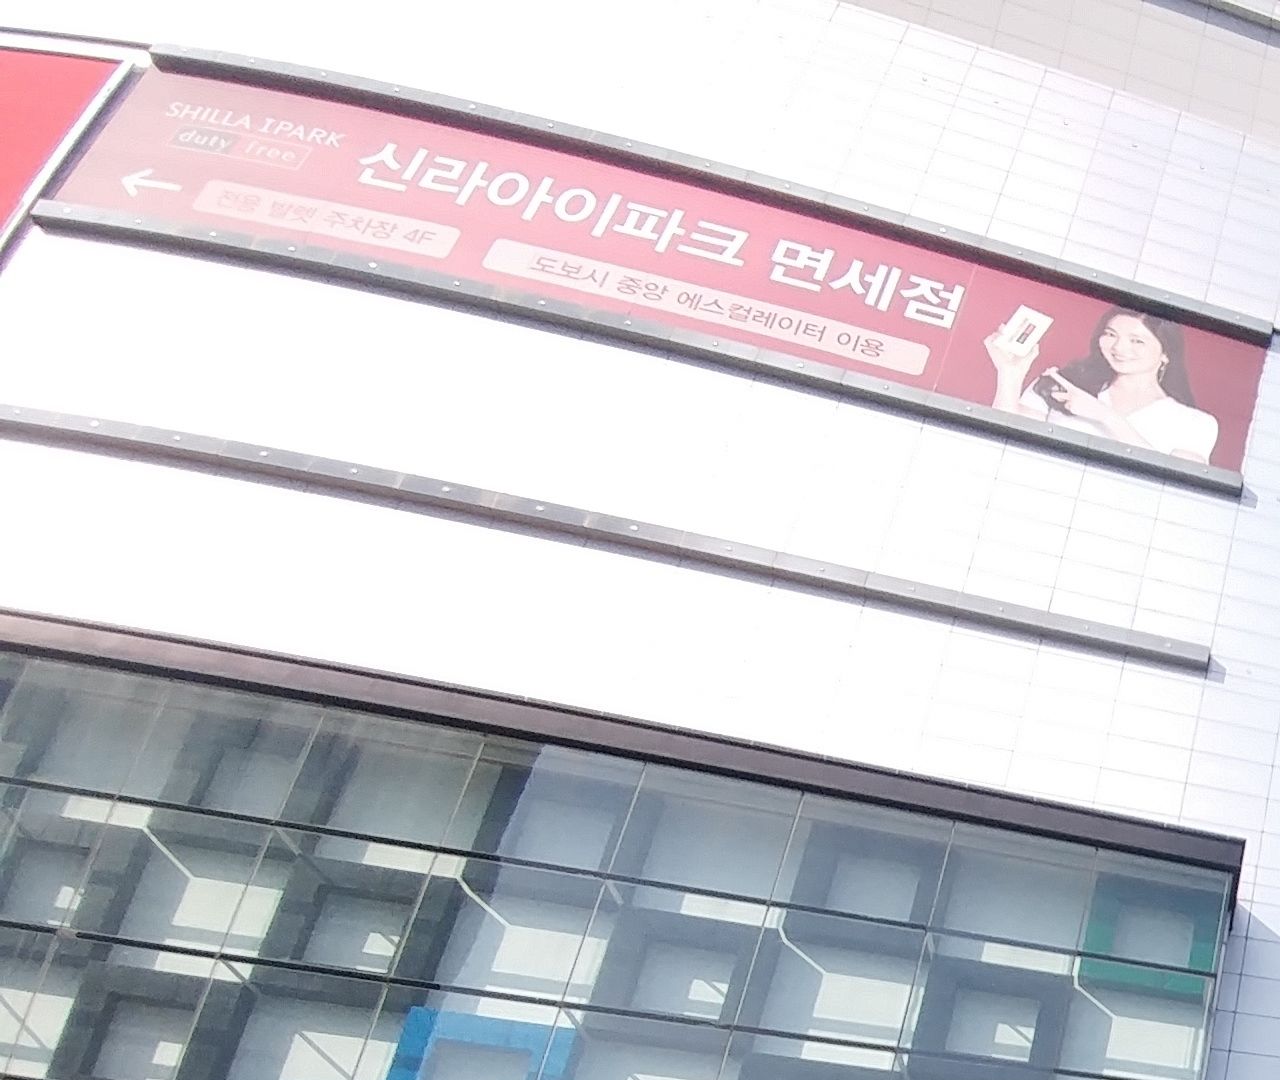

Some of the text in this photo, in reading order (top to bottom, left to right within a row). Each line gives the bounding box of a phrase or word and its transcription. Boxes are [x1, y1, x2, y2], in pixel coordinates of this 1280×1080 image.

[166, 102, 348, 147] SHILLA IPARK
[178, 128, 296, 162] duty free
[323, 211, 398, 240] 주차장
[402, 229, 438, 247] 4F
[358, 141, 967, 330] 신라아이파크 면세점
[529, 254, 885, 358] 도보시 중앙 에스컬레이터 이용
